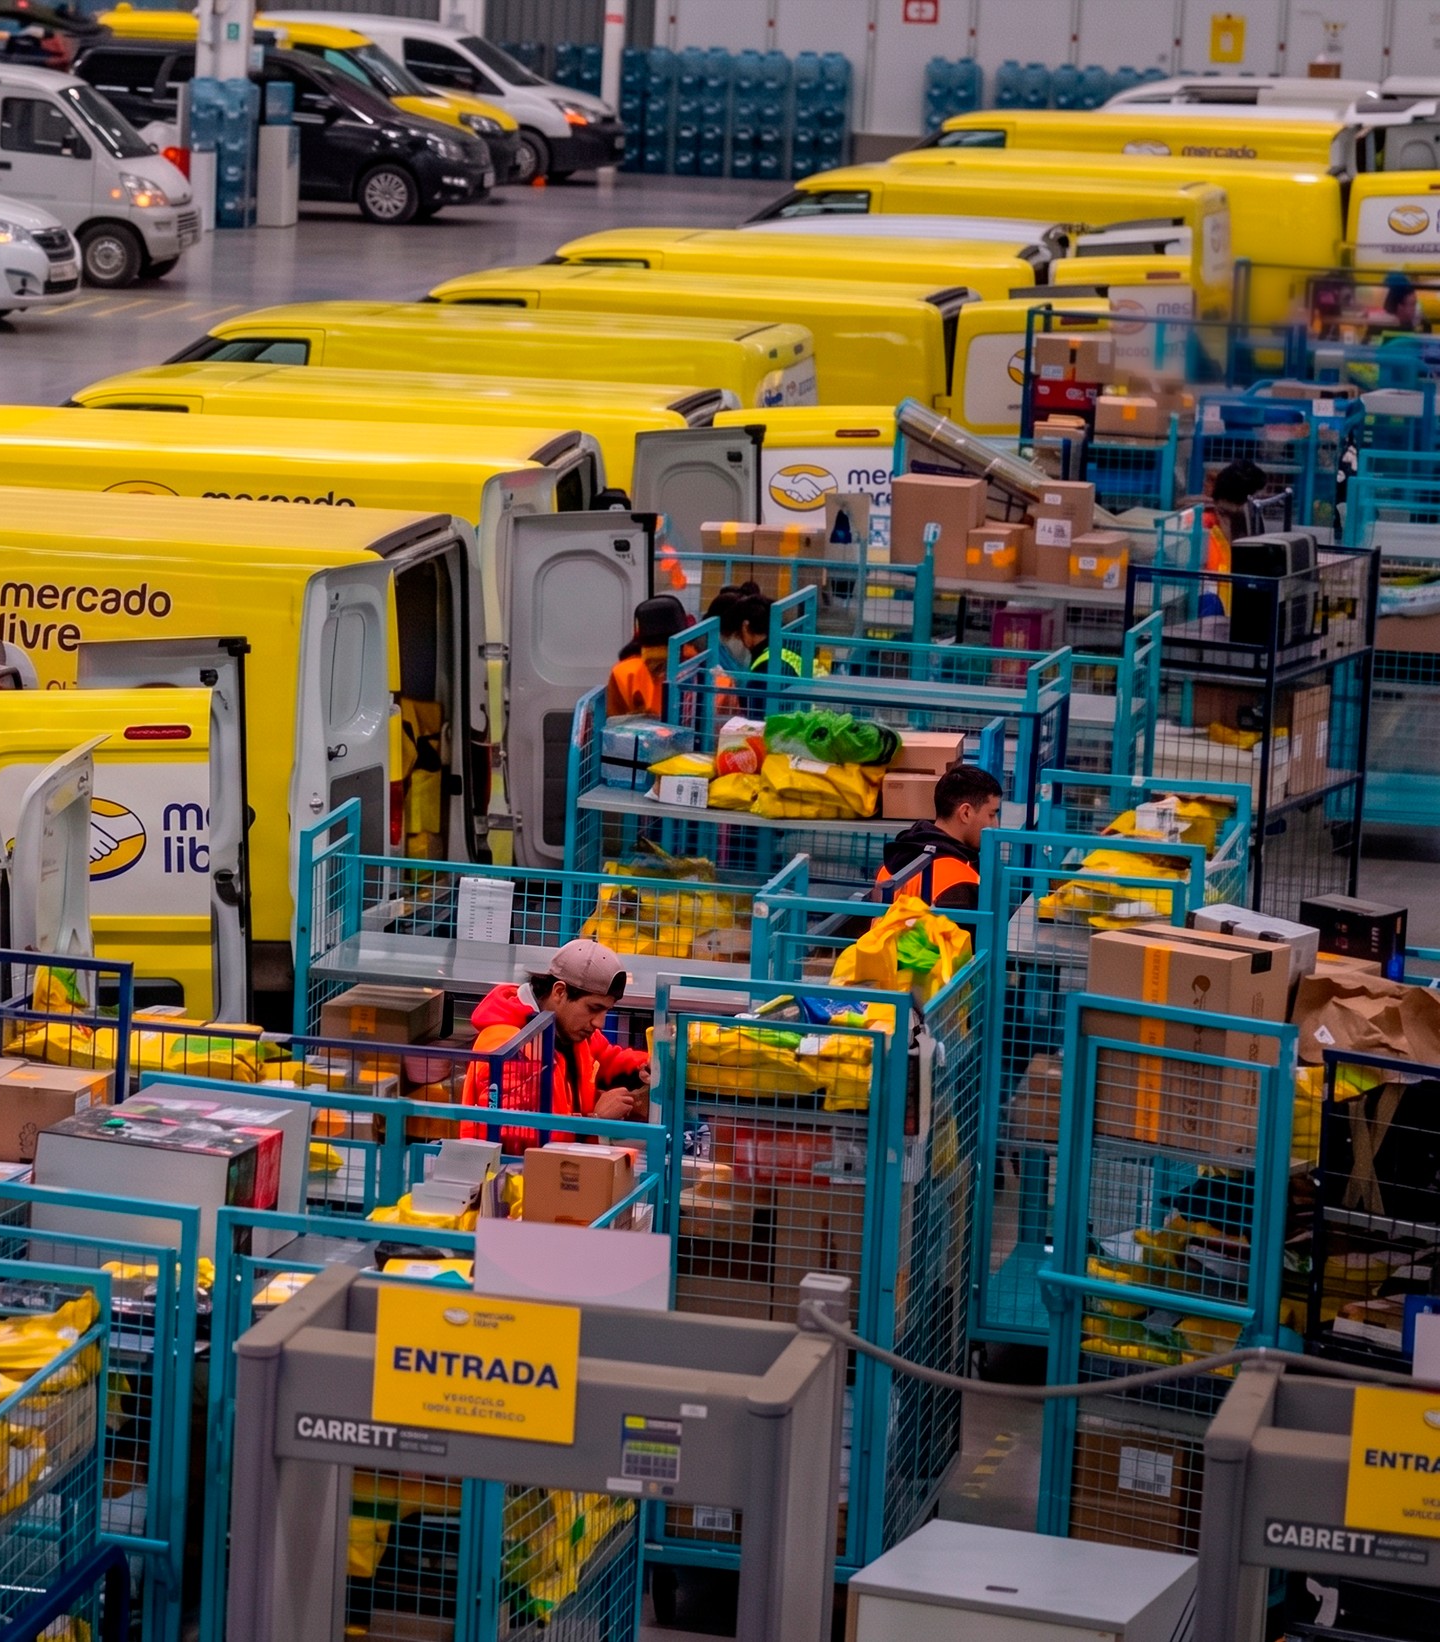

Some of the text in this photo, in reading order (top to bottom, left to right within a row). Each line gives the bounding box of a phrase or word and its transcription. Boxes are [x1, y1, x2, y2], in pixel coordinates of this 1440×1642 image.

[847, 468, 895, 485] mer
[0, 582, 172, 618] mercado
[164, 835, 210, 873] lib
[393, 1345, 559, 1390] ENTRADA
[297, 1416, 398, 1449] CARRETT
